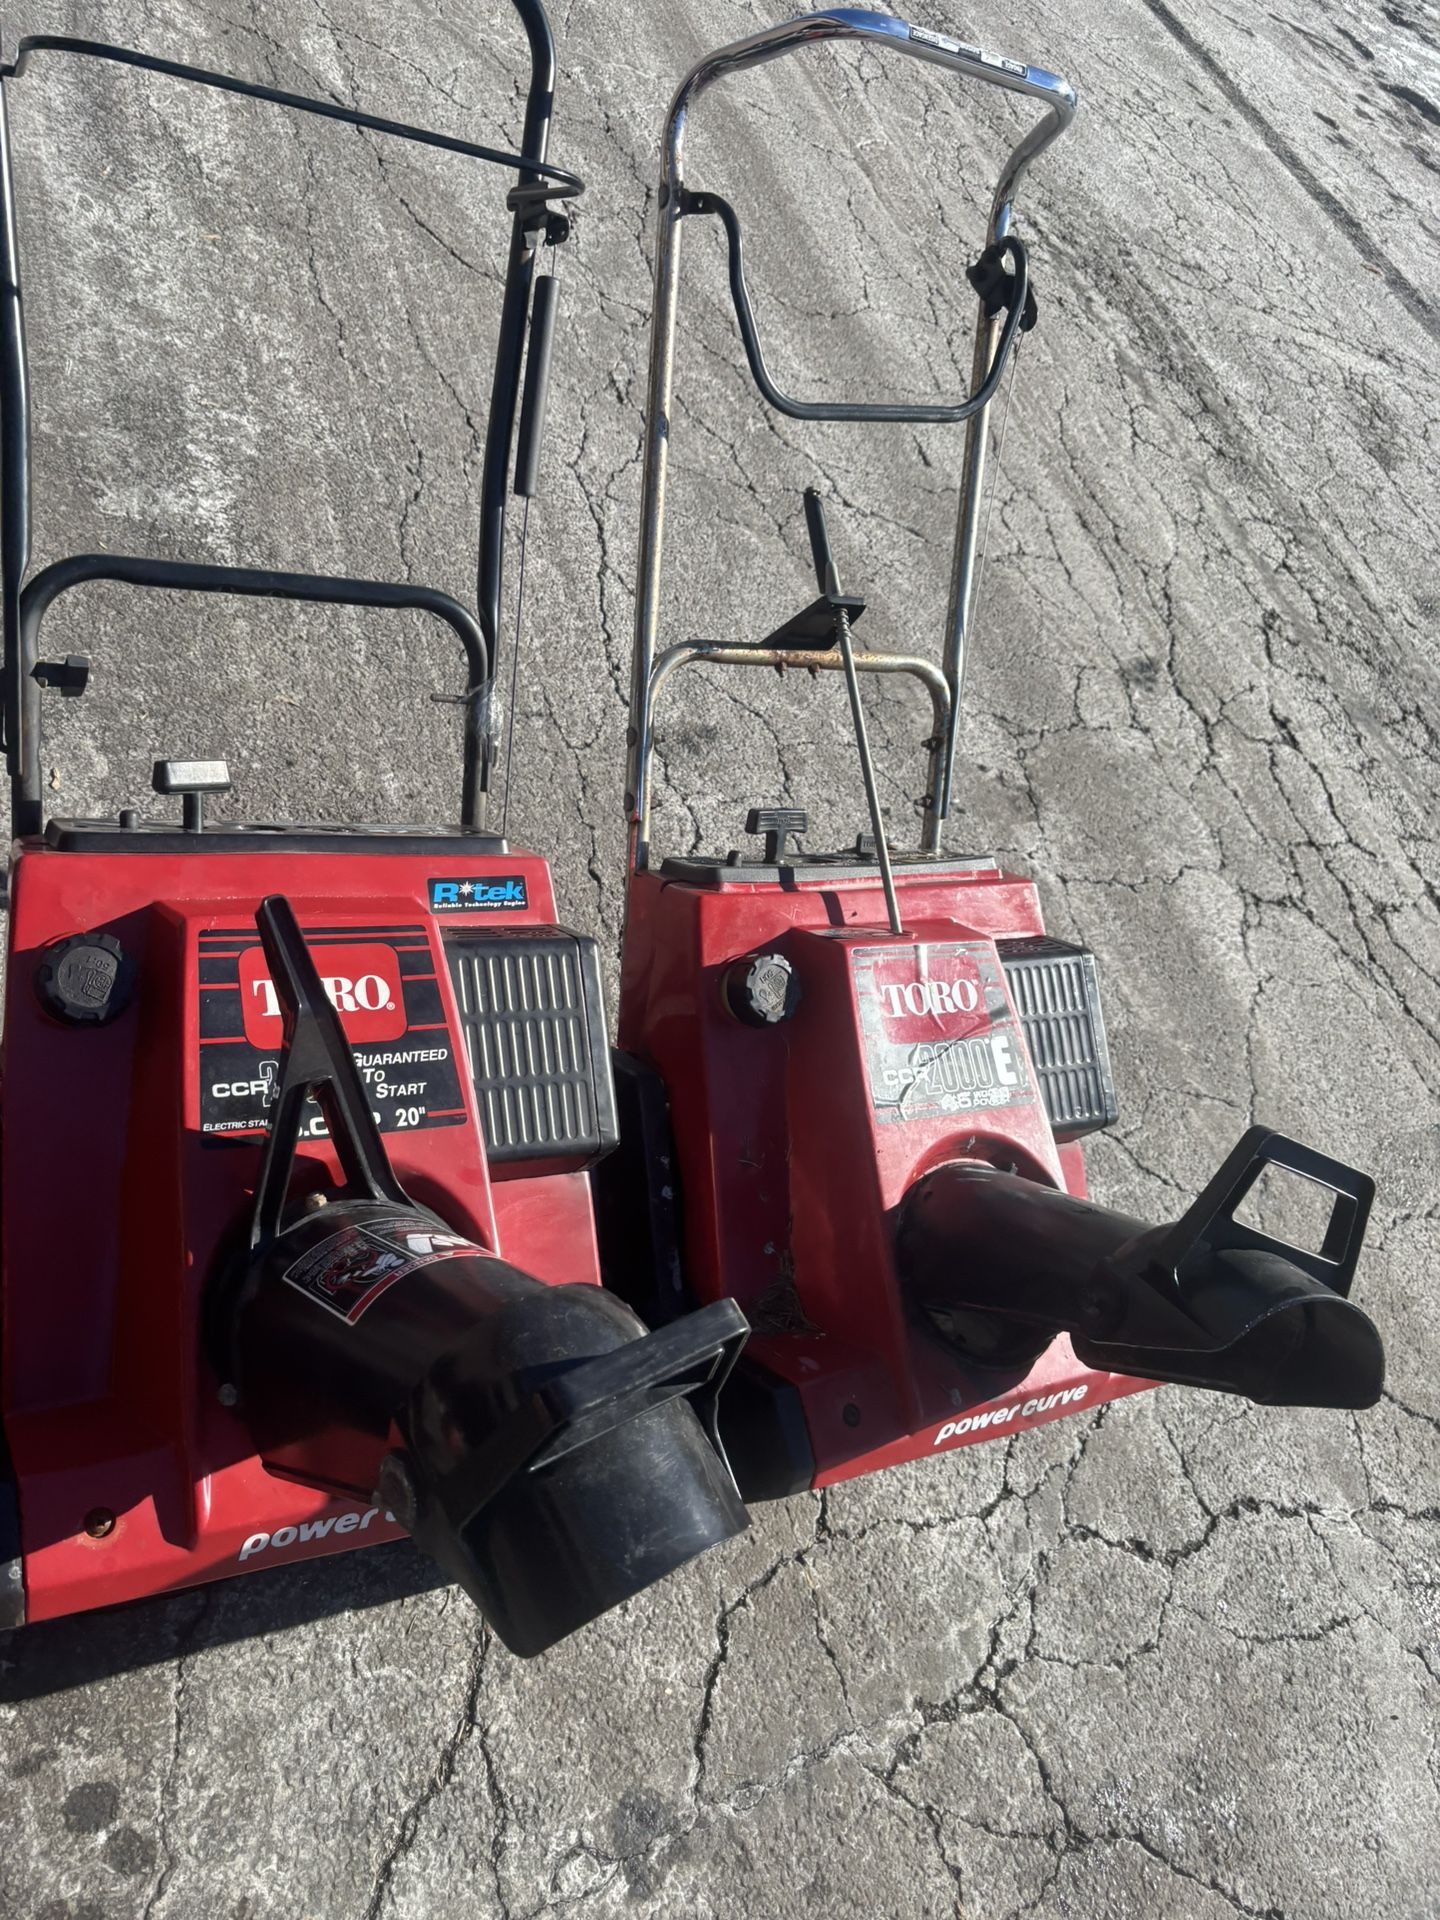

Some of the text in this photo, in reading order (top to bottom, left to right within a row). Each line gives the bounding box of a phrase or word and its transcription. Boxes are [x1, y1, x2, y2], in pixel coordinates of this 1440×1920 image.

[464, 900, 502, 908] Technology
[253, 975, 391, 1016] TRO
[880, 979, 978, 1018] TORO
[352, 1048, 449, 1067] GUARANTEED
[211, 1080, 270, 1098] CCR
[375, 1082, 427, 1099] START
[203, 1119, 269, 1132] ELECTRIC STA
[395, 1106, 426, 1127] 20"
[933, 1384, 1089, 1446] power curve
[238, 1508, 379, 1562] power
